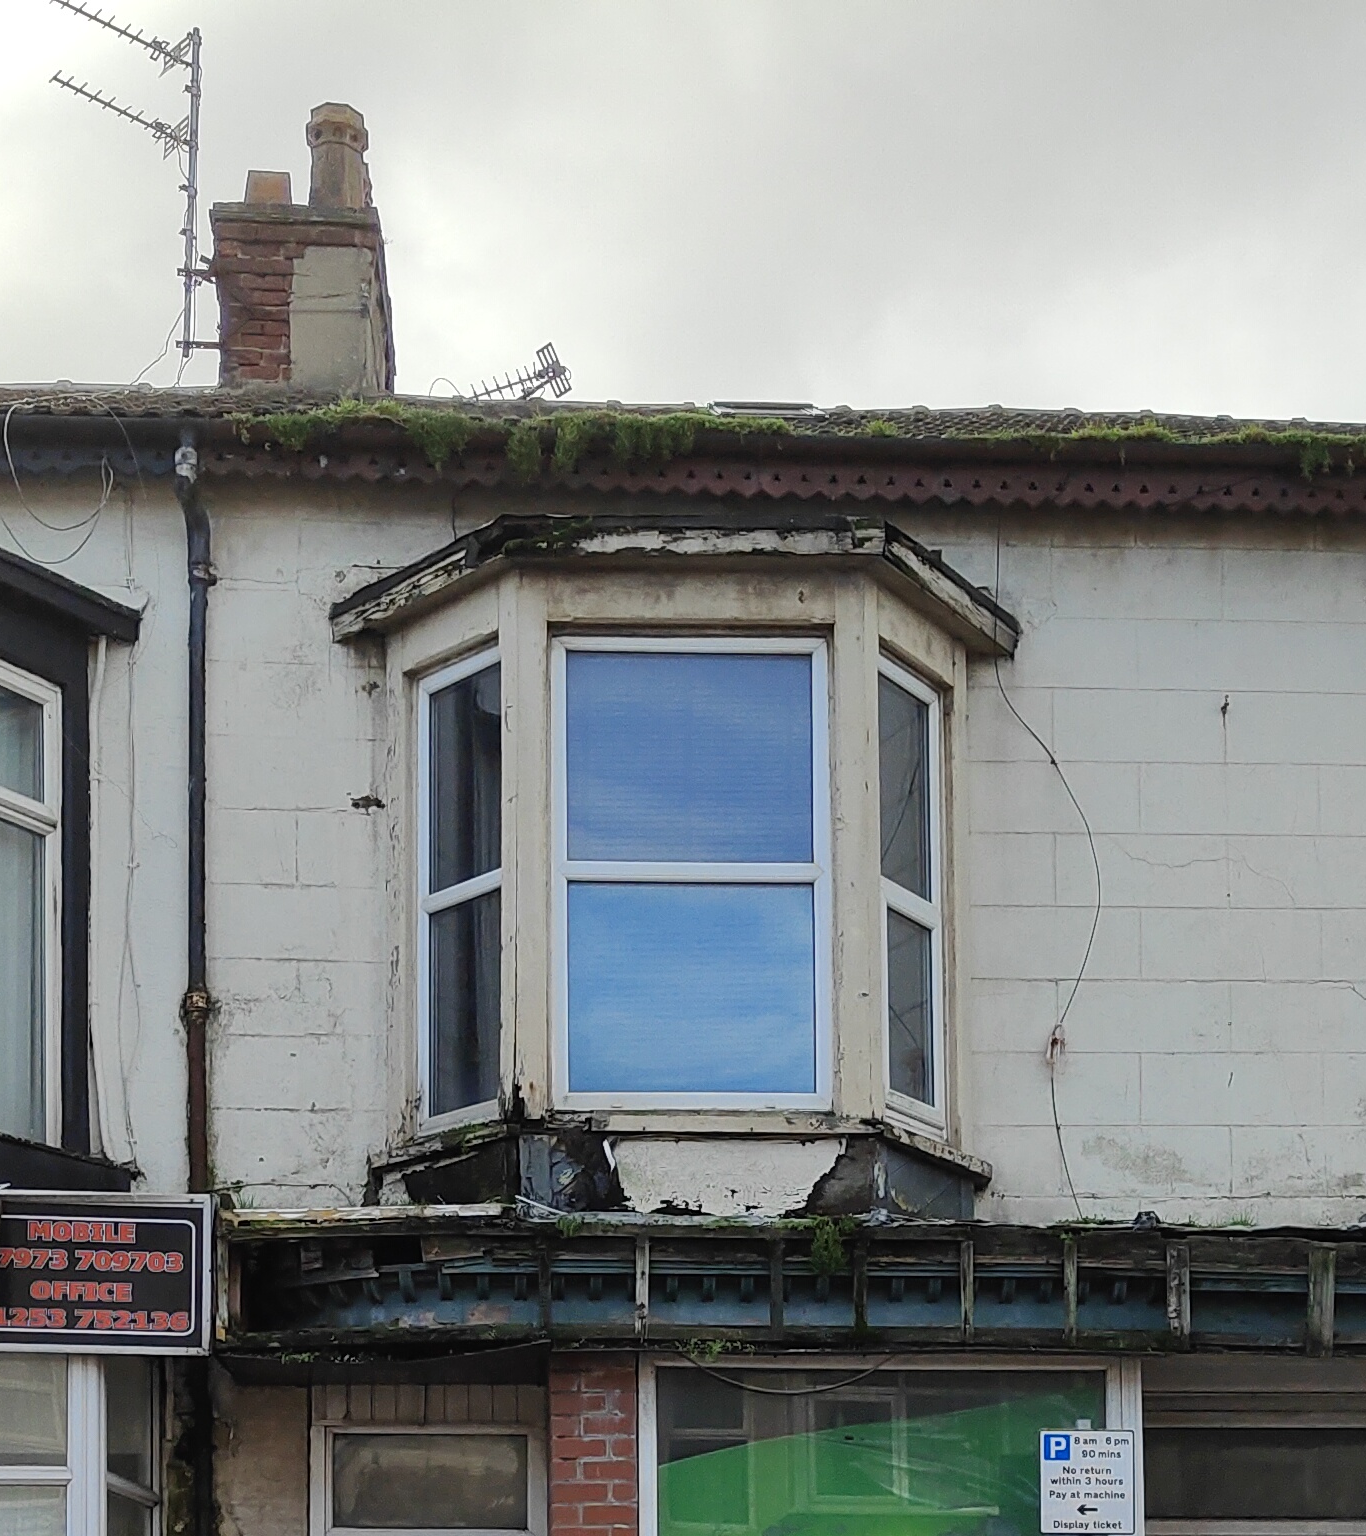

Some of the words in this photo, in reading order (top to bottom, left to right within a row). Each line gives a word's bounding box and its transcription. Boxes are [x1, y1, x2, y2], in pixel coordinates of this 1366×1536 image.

[28, 1220, 136, 1243] MOBILE
[75, 1251, 184, 1273] 709703
[30, 1280, 133, 1302] OFFICE
[74, 1308, 189, 1331] 752136
[1049, 1436, 1067, 1459] P
[1081, 1449, 1096, 1458] 90
[1098, 1449, 1122, 1458] mins
[1062, 1466, 1077, 1475] No
[1080, 1466, 1112, 1475] return
[1050, 1477, 1081, 1485] within
[1084, 1477, 1092, 1485] 3
[1095, 1476, 1124, 1485] hours
[1049, 1490, 1067, 1500] Pay
[1070, 1491, 1080, 1499] at
[1083, 1490, 1126, 1499] machine
[1053, 1520, 1090, 1530] Display
[1093, 1520, 1123, 1529] ticket
